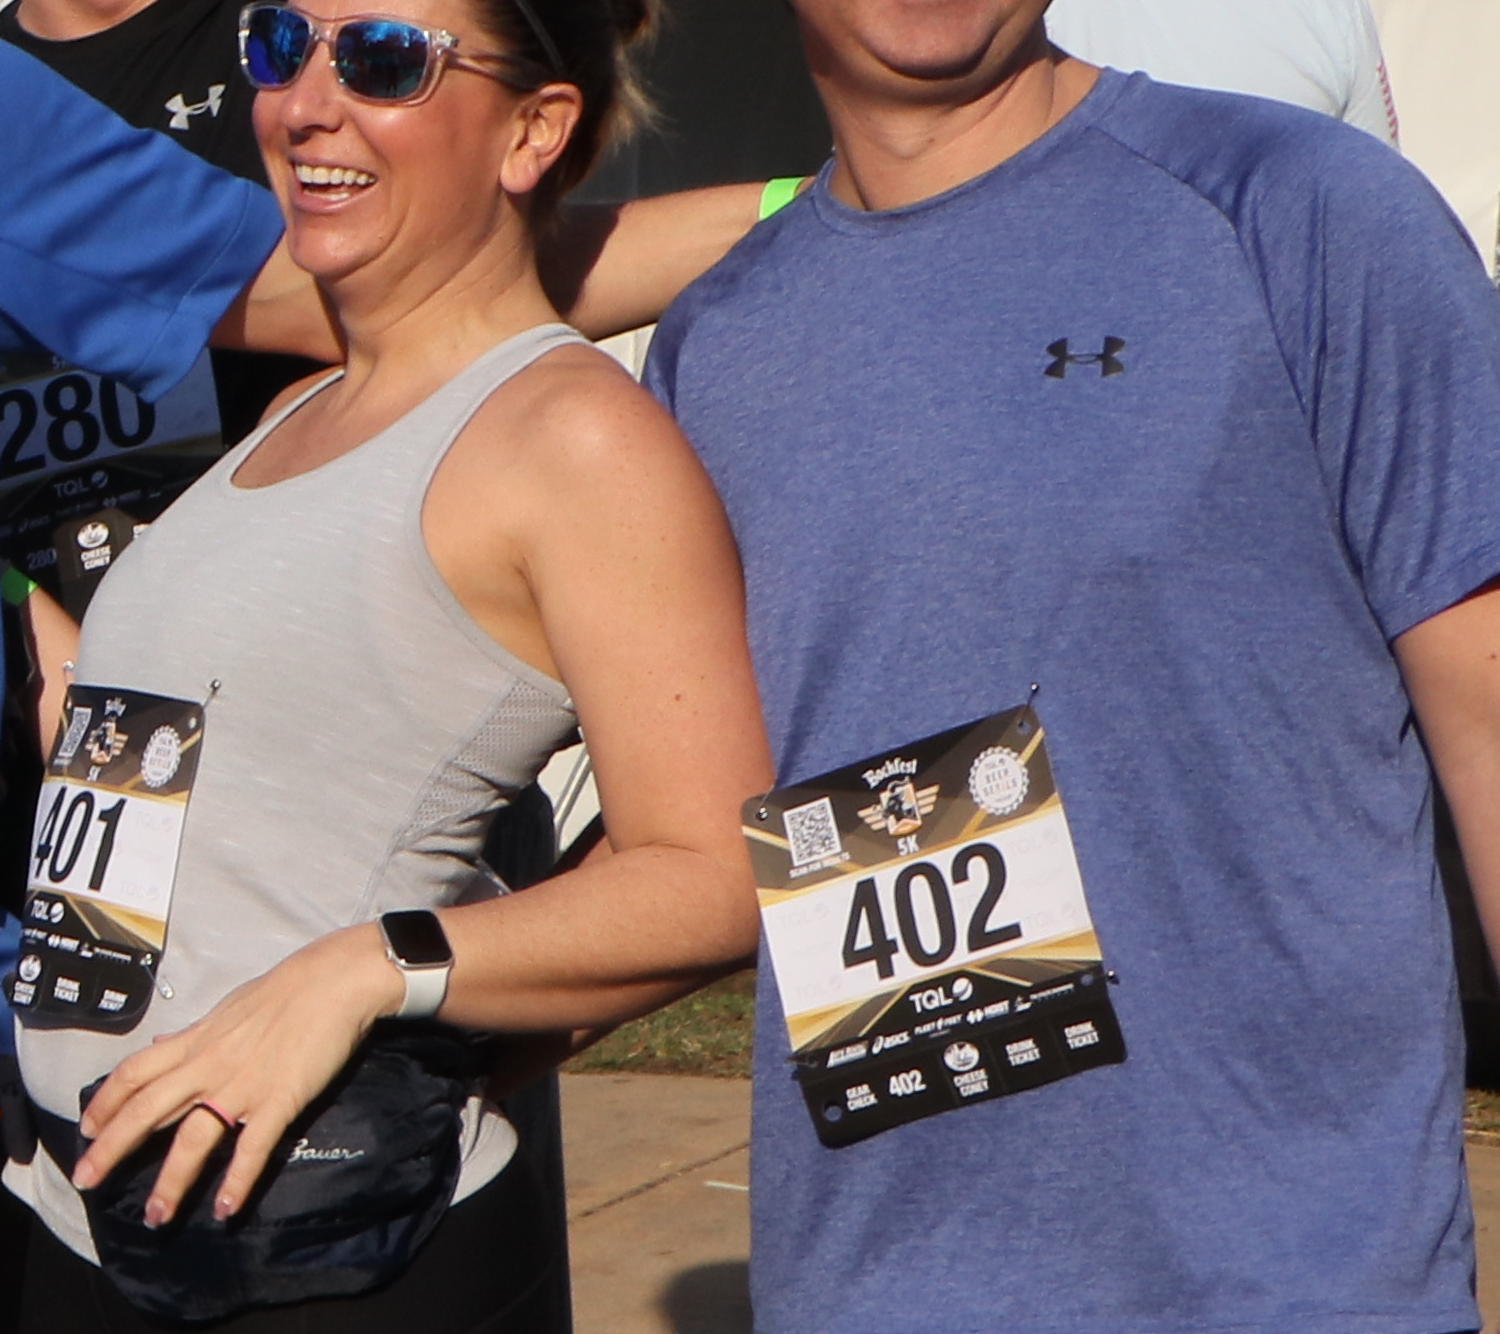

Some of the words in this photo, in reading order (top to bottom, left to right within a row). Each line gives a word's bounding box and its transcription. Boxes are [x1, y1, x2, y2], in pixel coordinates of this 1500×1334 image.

[54, 480, 88, 498] TQL
[27, 547, 58, 570] 280
[861, 757, 918, 789] Bockfest
[34, 786, 128, 892] 401
[897, 836, 919, 856] 5K
[842, 841, 1022, 981] 402
[909, 987, 953, 1013] TQL
[888, 1068, 926, 1098] 402
